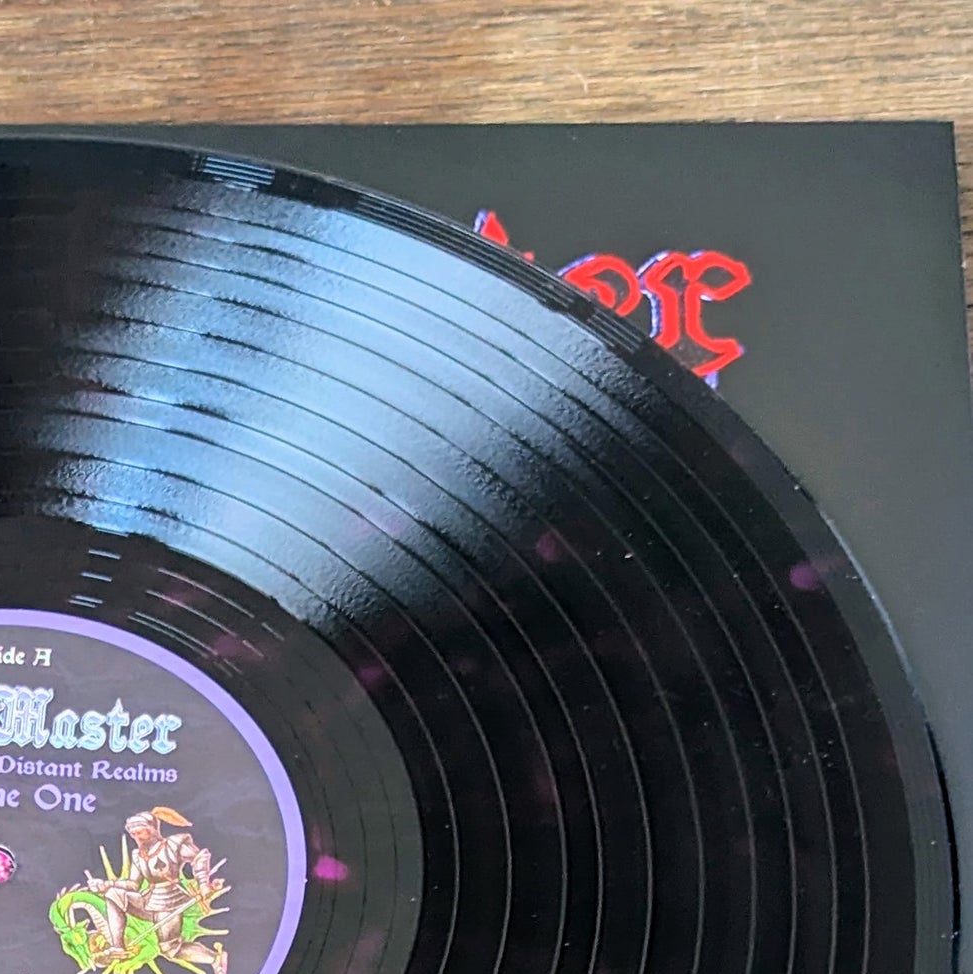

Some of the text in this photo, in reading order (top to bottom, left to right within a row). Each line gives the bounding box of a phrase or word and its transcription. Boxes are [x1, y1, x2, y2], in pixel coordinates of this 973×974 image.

[31, 647, 54, 667] A
[91, 759, 178, 783] Realms
[33, 783, 98, 814] One
